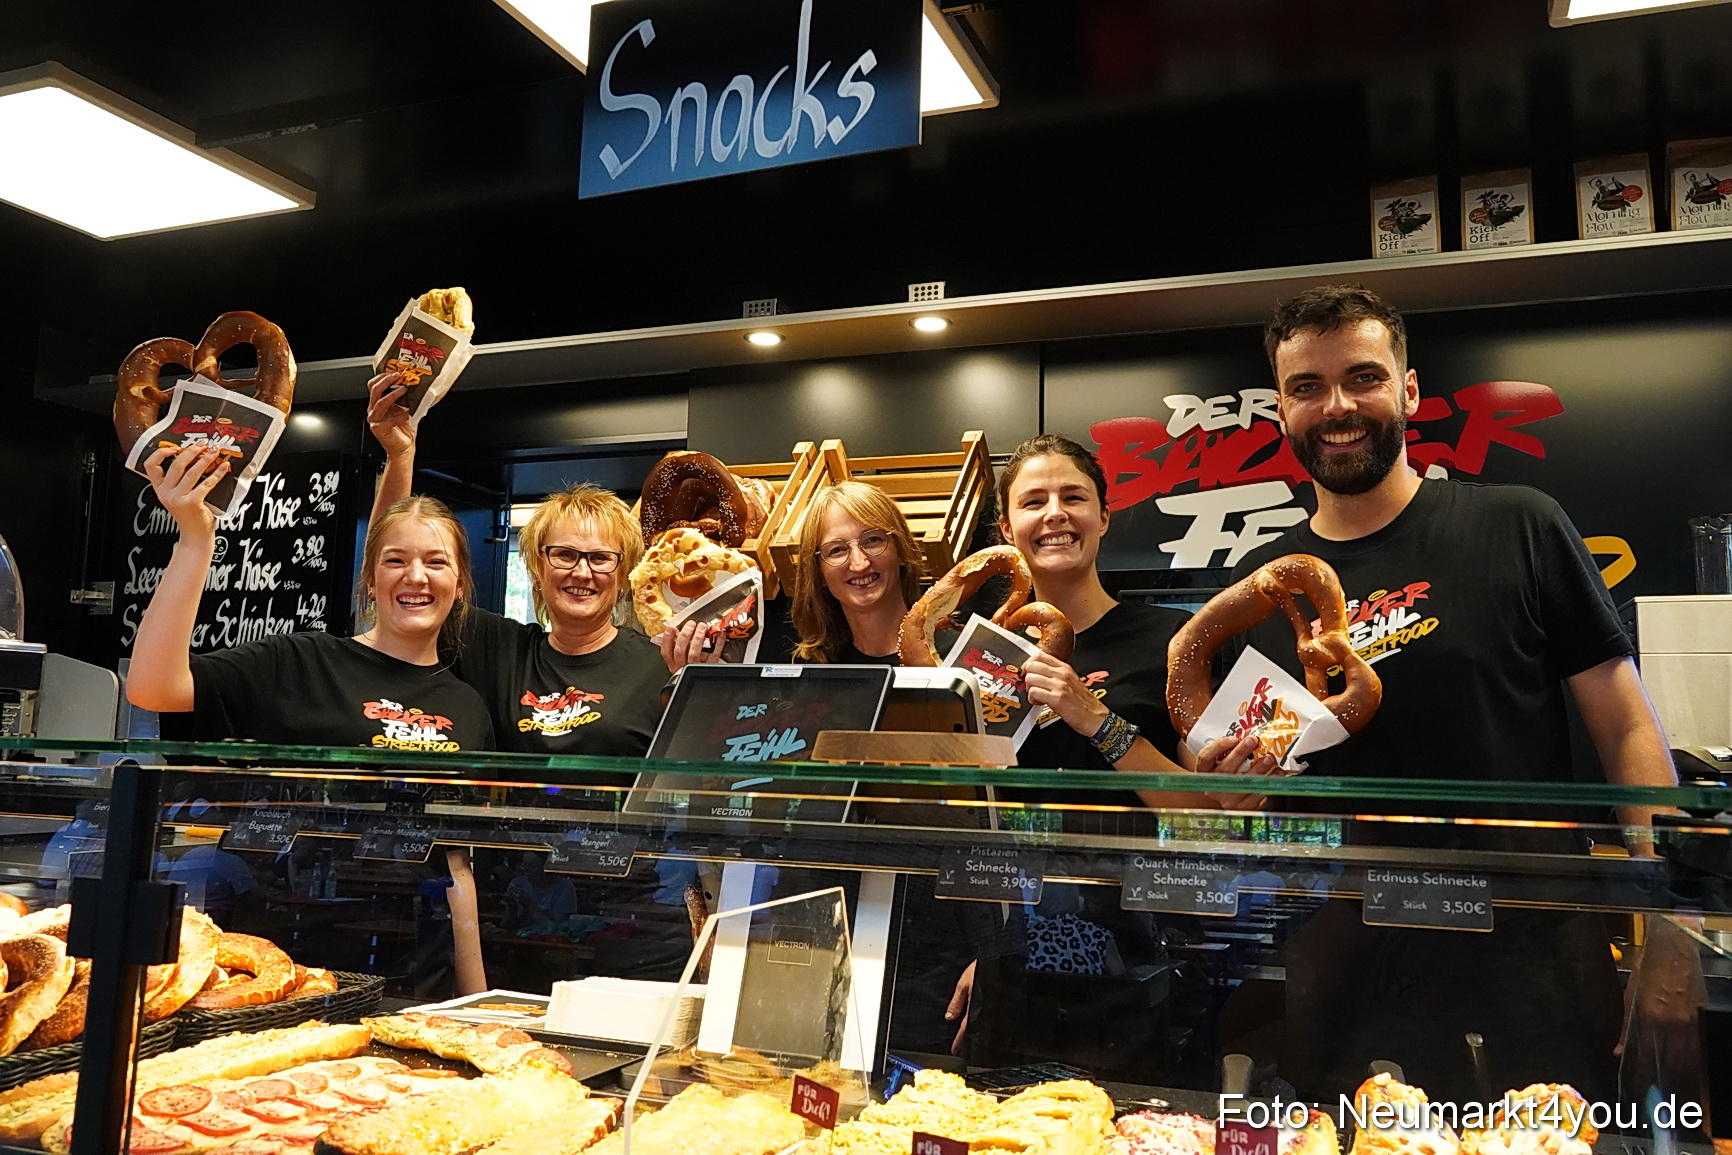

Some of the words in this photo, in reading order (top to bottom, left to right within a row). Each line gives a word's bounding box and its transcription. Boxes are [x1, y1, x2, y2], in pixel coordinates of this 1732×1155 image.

[598, 0, 878, 180] Snacks
[1379, 240, 1400, 251] Off
[1469, 233, 1490, 244] Off
[191, 414, 212, 424] DER
[1163, 388, 1280, 438] DER
[291, 535, 325, 565] 3.80
[210, 597, 296, 648] Schinken
[296, 593, 327, 625] 4.20
[982, 649, 1003, 667] DER
[380, 698, 403, 712] DER
[736, 703, 768, 721] DER
[517, 711, 602, 732] STREETFOOD
[371, 734, 461, 752] STREETFOOD
[252, 807, 292, 819] Knoblauch
[710, 807, 754, 818] VECTRON
[248, 820, 283, 834] Baguette
[268, 834, 293, 844] 3,50€
[401, 842, 429, 853] 5,50€
[969, 845, 1019, 858] Pistazien
[597, 855, 629, 867] 5,50€
[965, 860, 1018, 874] Schnecke
[969, 877, 990, 886] Stück
[1001, 877, 1039, 890] 3,90€
[1153, 873, 1208, 888] Schnecke
[1367, 870, 1420, 885] Erdnuss
[1422, 873, 1488, 888] Schnecke
[1146, 890, 1169, 901] Stück
[1195, 890, 1236, 905] 3,50€
[1403, 899, 1428, 911] Stück
[1441, 900, 1486, 915] 3,50€
[774, 940, 810, 950] VECTRON
[797, 1083, 818, 1100] FÜR
[801, 1097, 831, 1122] Dich!
[1221, 1128, 1249, 1144] FÜR
[916, 1139, 942, 1155] FÜR
